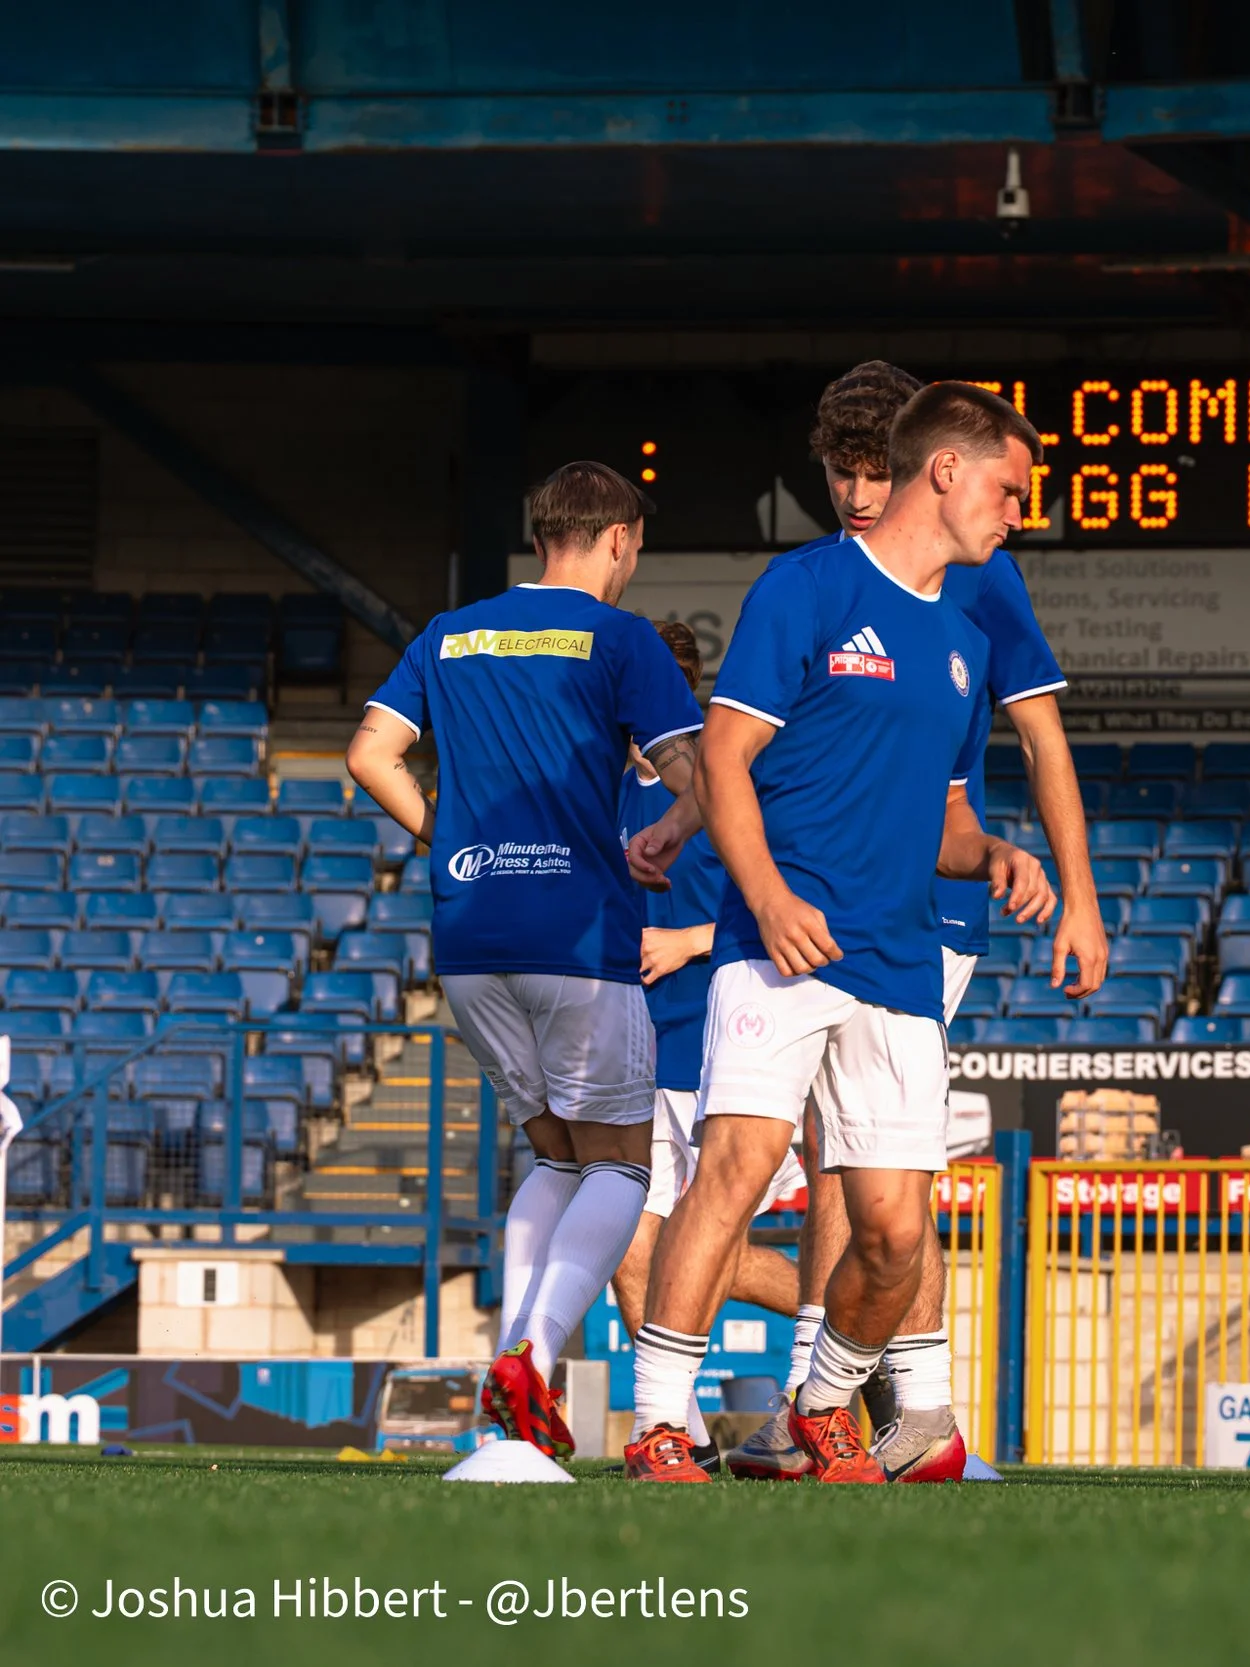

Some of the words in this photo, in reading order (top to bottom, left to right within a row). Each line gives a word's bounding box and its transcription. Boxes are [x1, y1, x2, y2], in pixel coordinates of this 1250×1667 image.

[1022, 463, 1178, 530] IGG
[1027, 556, 1087, 580] Fleet
[1095, 556, 1213, 580] Solutions
[1030, 586, 1099, 613] tions,
[1106, 586, 1222, 613] Servicing
[1075, 616, 1164, 642] Testing
[498, 637, 589, 654] ELECTRICAL
[1157, 646, 1250, 674] Repairs
[496, 842, 571, 857] Minuteman
[492, 856, 530, 870] Press
[532, 857, 571, 869] Ashton
[1056, 1177, 1182, 1210] Storage
